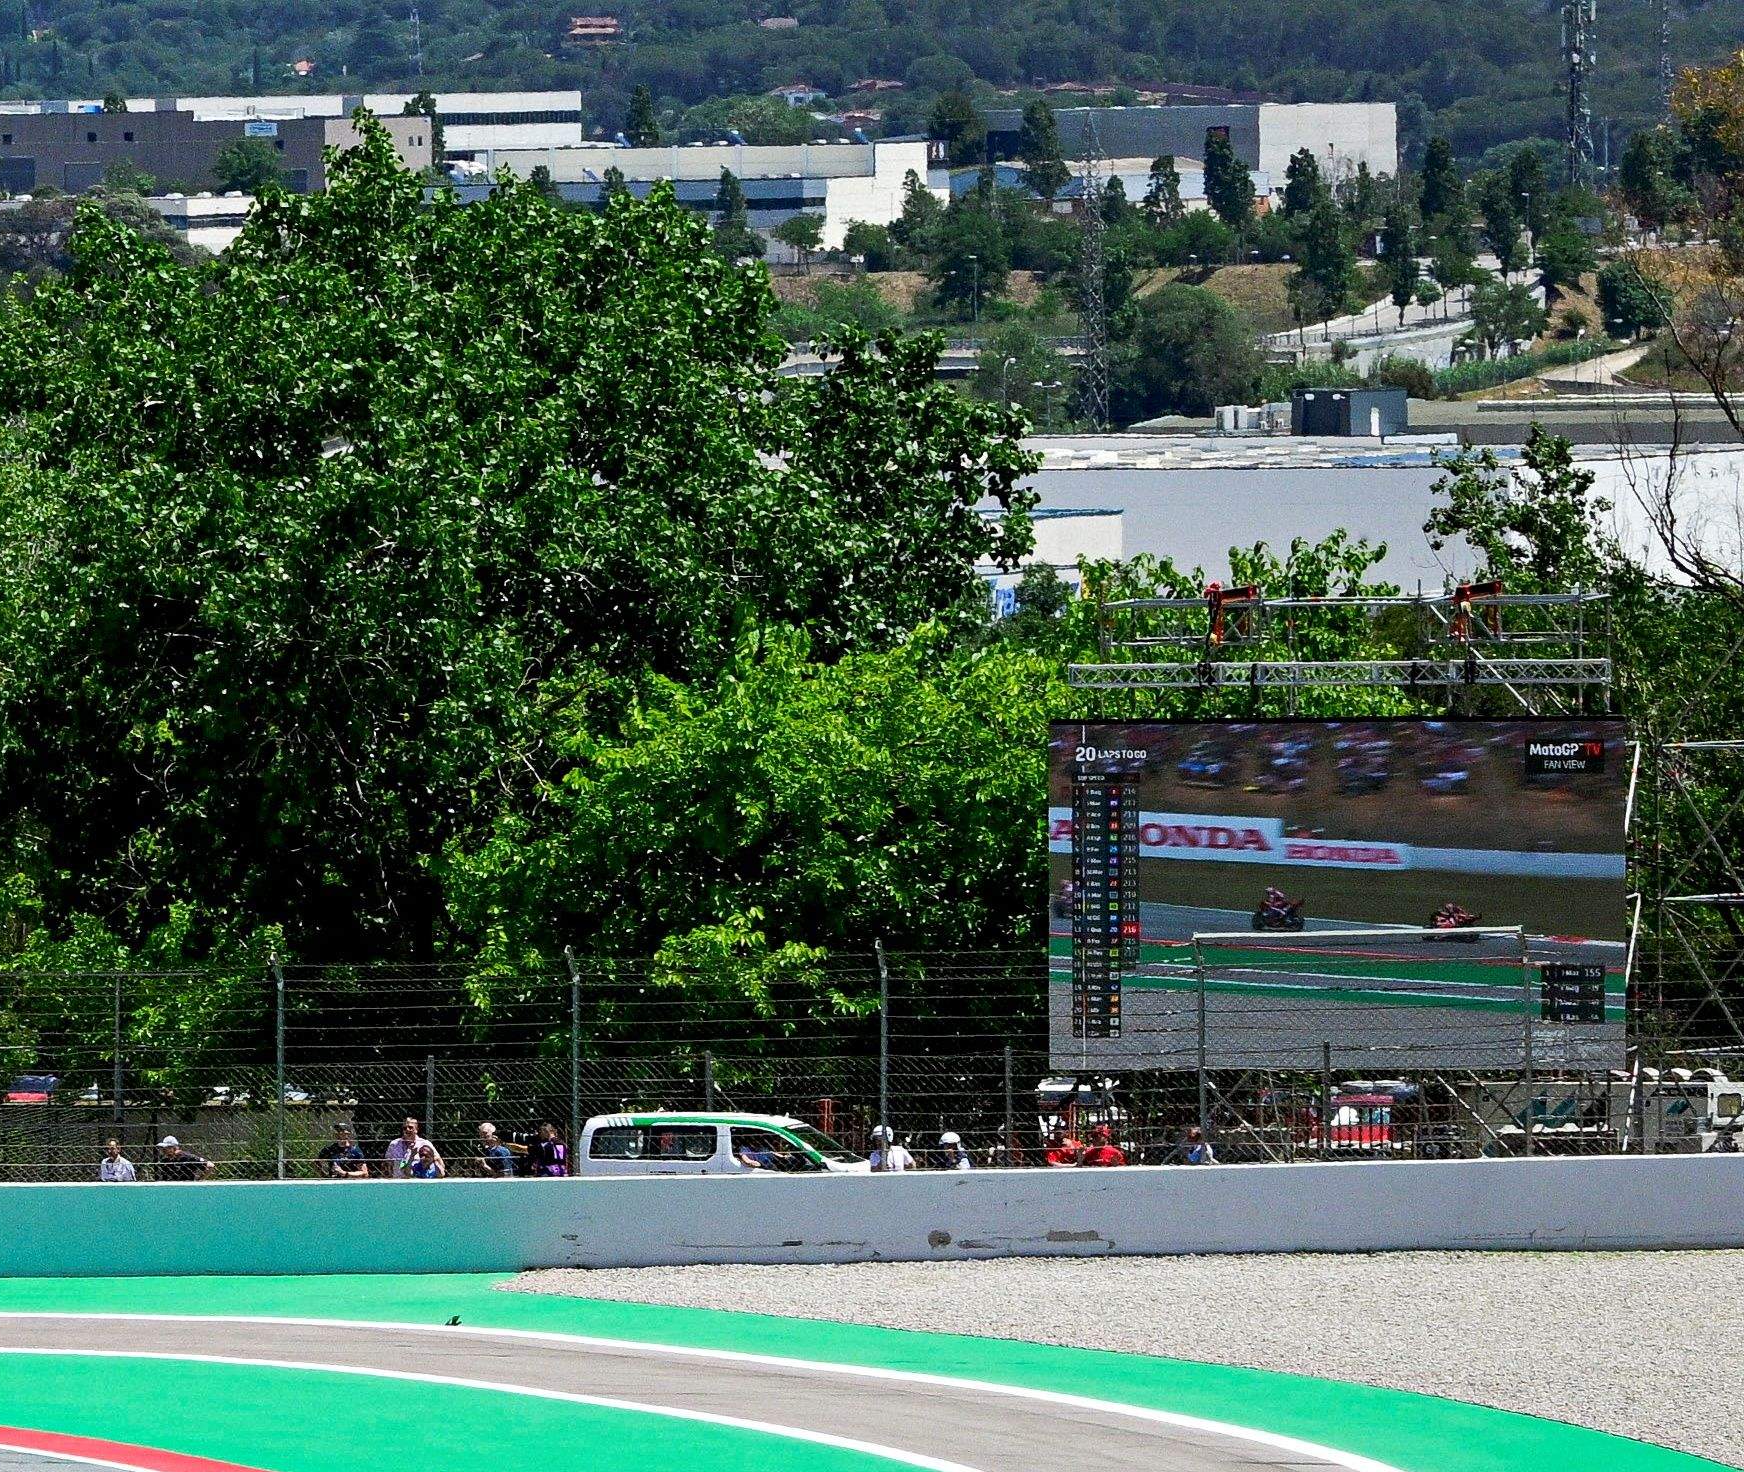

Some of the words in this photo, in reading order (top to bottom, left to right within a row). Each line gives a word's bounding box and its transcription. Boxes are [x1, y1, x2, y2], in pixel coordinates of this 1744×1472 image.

[1075, 747, 1096, 762] 20
[1098, 750, 1120, 759] LAPS
[1120, 750, 1133, 759] TO
[1134, 750, 1147, 759] GO
[1529, 743, 1579, 756] MotoGP
[1544, 760, 1561, 769] FAN
[1562, 760, 1586, 769] VIEW
